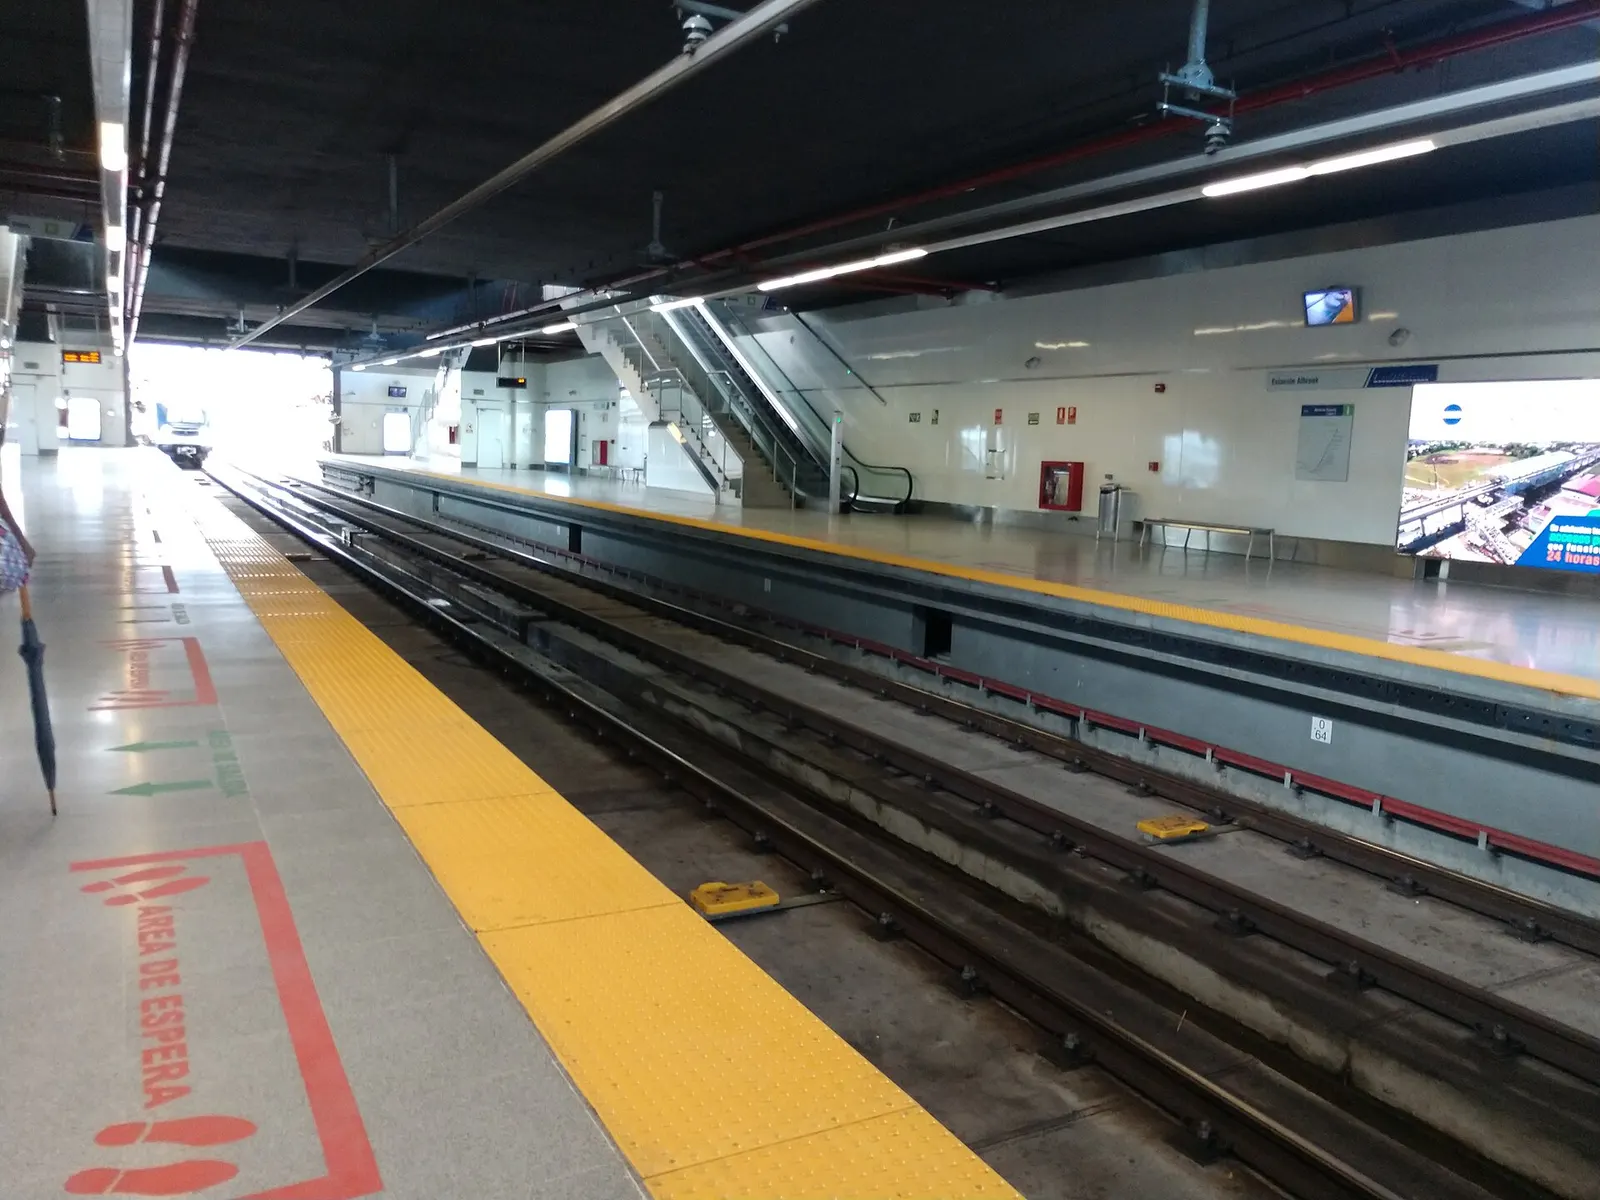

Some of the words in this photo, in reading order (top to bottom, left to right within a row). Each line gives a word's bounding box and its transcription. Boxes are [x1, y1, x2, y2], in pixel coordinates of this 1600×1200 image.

[1546, 550, 1562, 562] 24
[1565, 552, 1600, 566] horas
[1319, 720, 1325, 729] 0
[1315, 730, 1327, 740] 64
[138, 957, 182, 991] DE
[139, 994, 191, 1109] ESPERA
